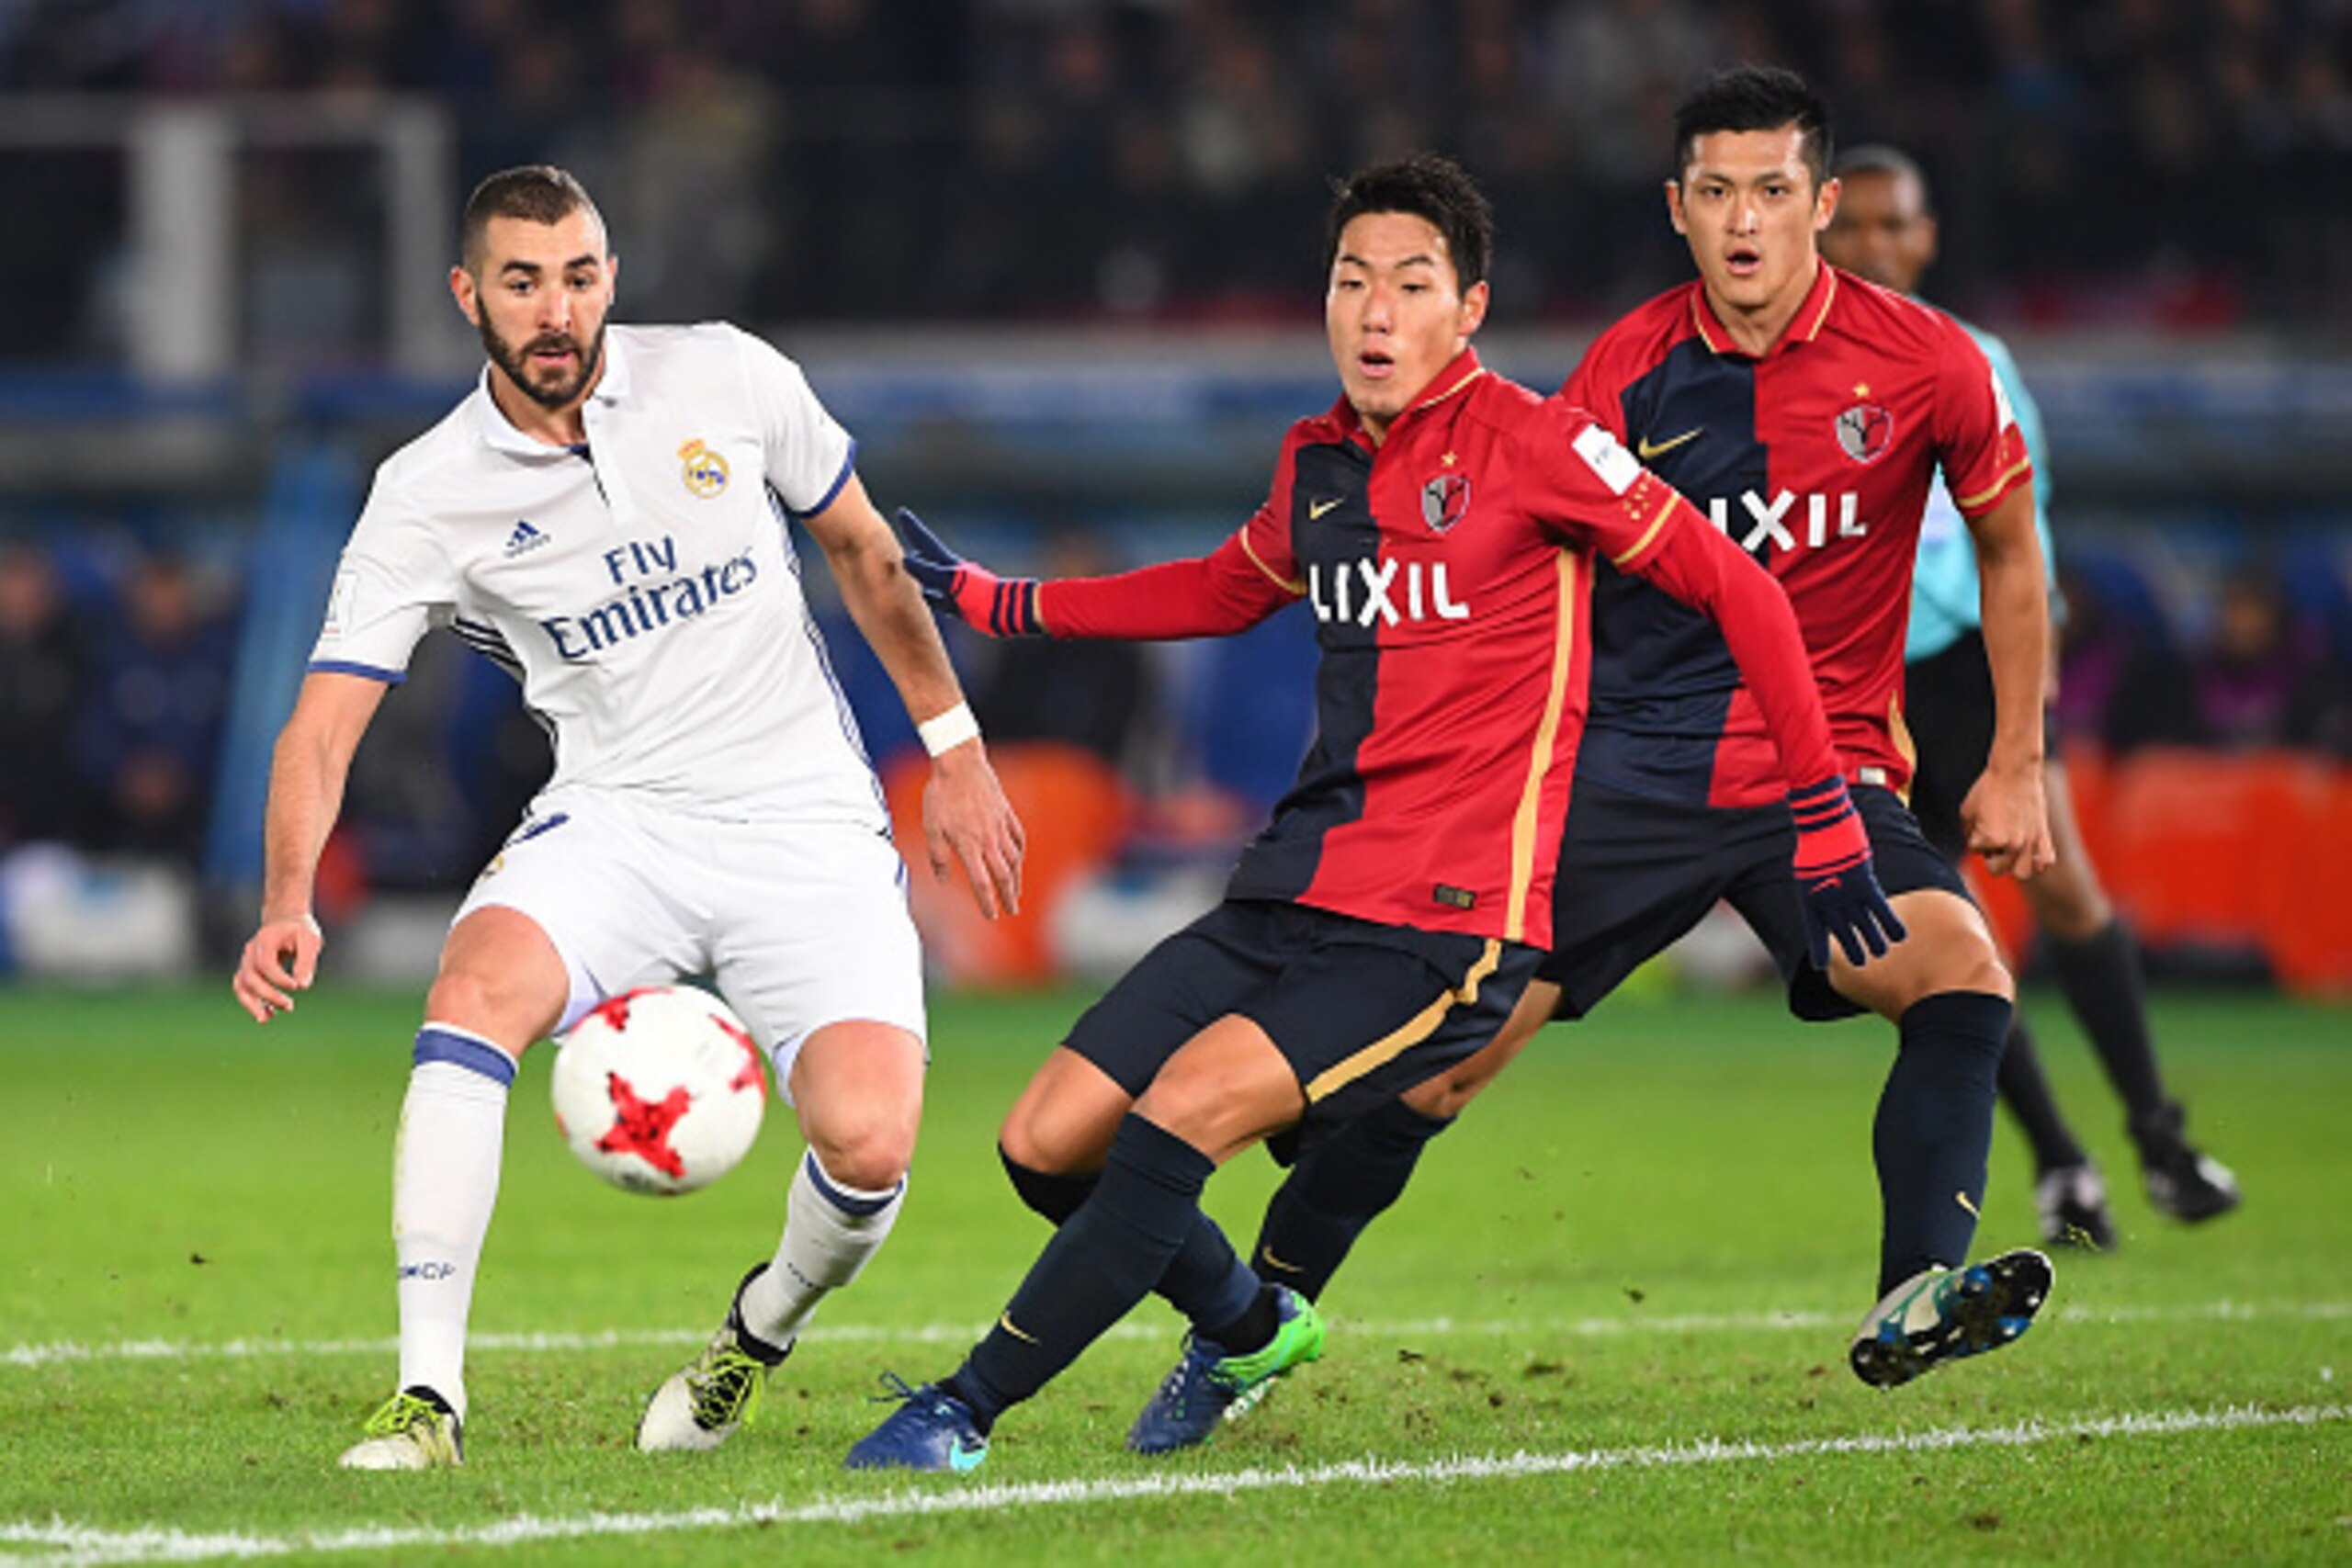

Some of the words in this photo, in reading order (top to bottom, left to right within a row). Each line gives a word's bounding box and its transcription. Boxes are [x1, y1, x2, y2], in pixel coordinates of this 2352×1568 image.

[1709, 488, 1868, 552] IXIL
[603, 534, 677, 585] Fly
[1308, 557, 1470, 628] LIXIL
[538, 547, 757, 660] Emirates
